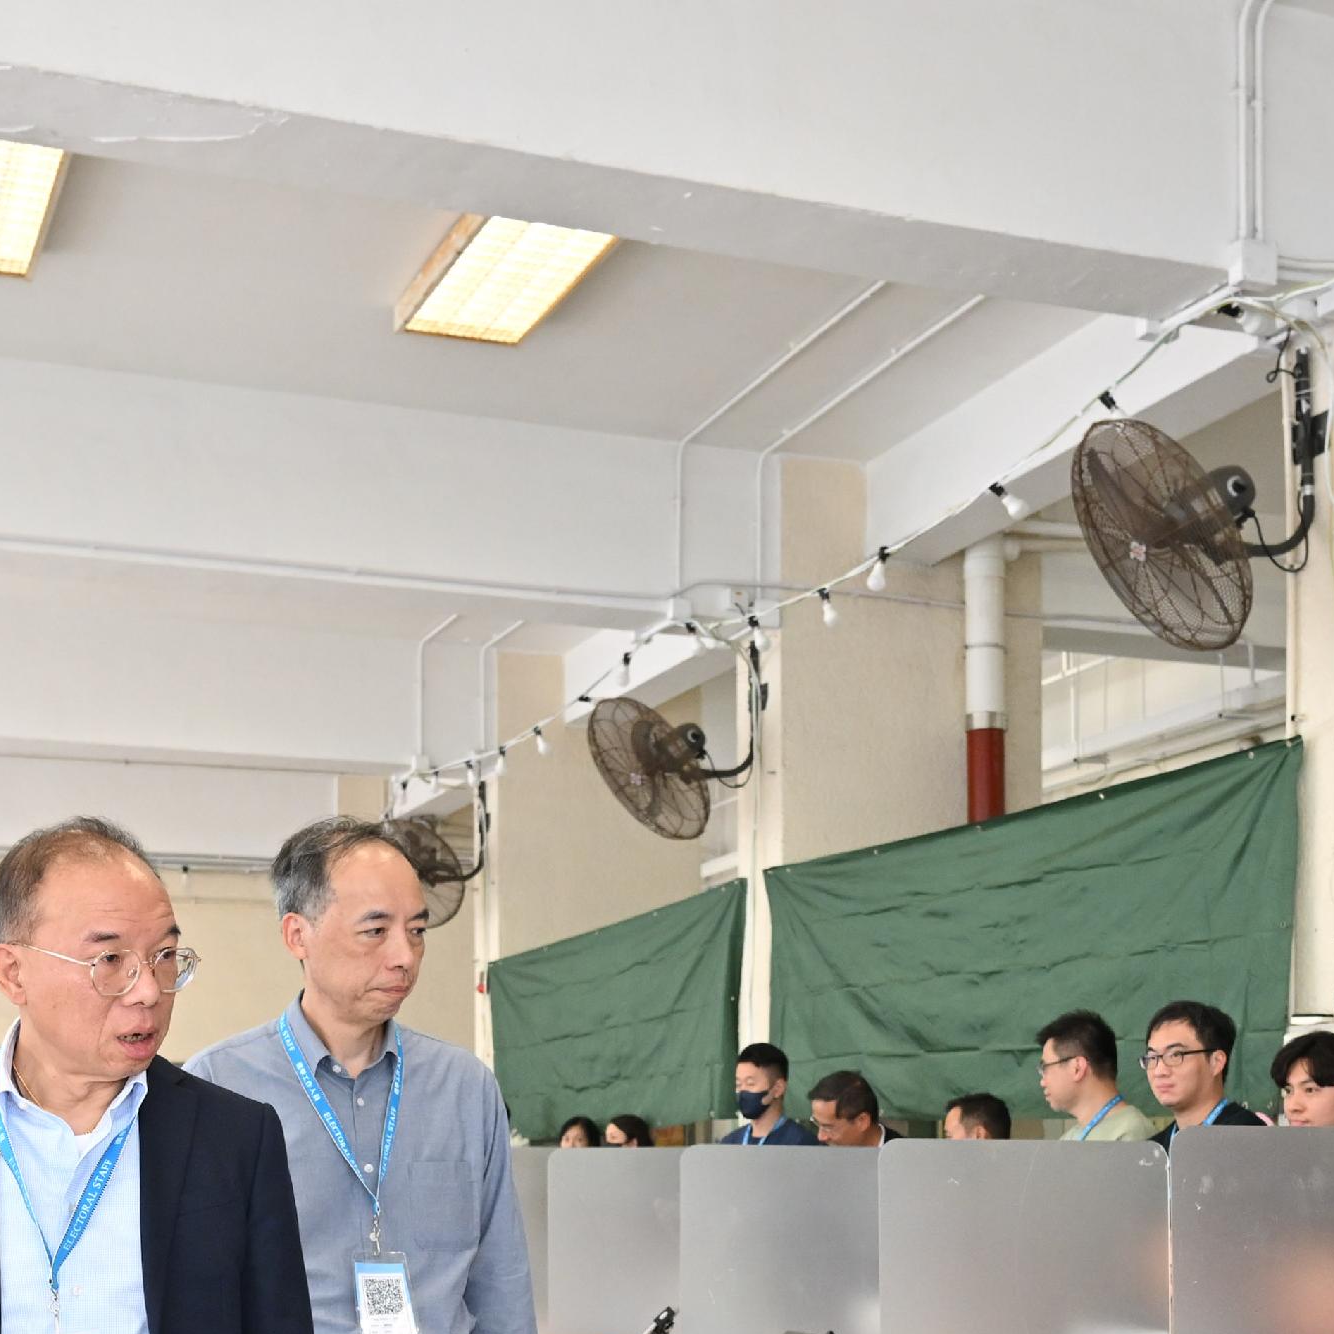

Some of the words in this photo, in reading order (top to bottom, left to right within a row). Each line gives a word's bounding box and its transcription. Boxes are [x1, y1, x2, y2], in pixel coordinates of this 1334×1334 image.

[323, 1111, 351, 1160] ELECTORAL
[63, 1192, 98, 1251] ELECTORAL
[93, 1159, 113, 1189] STAFF
